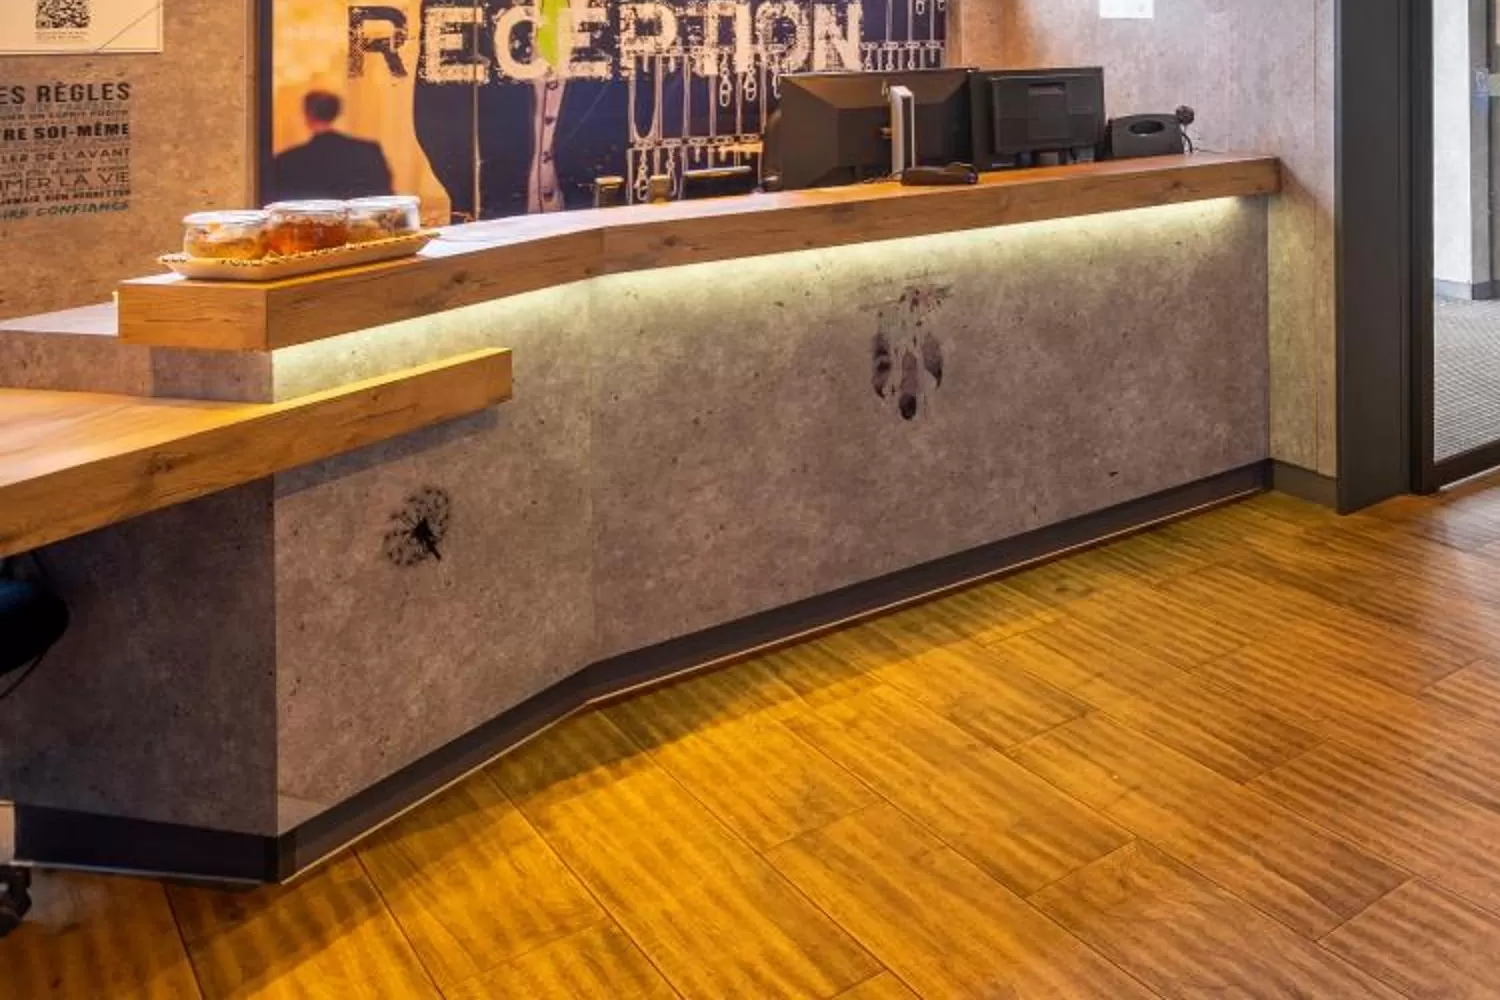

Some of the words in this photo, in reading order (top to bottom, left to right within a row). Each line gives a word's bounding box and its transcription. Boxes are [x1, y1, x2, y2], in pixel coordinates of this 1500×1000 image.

[37, 81, 130, 102] RÈGLES
[0, 127, 27, 141] RE
[34, 122, 129, 139] SOI-MÊME
